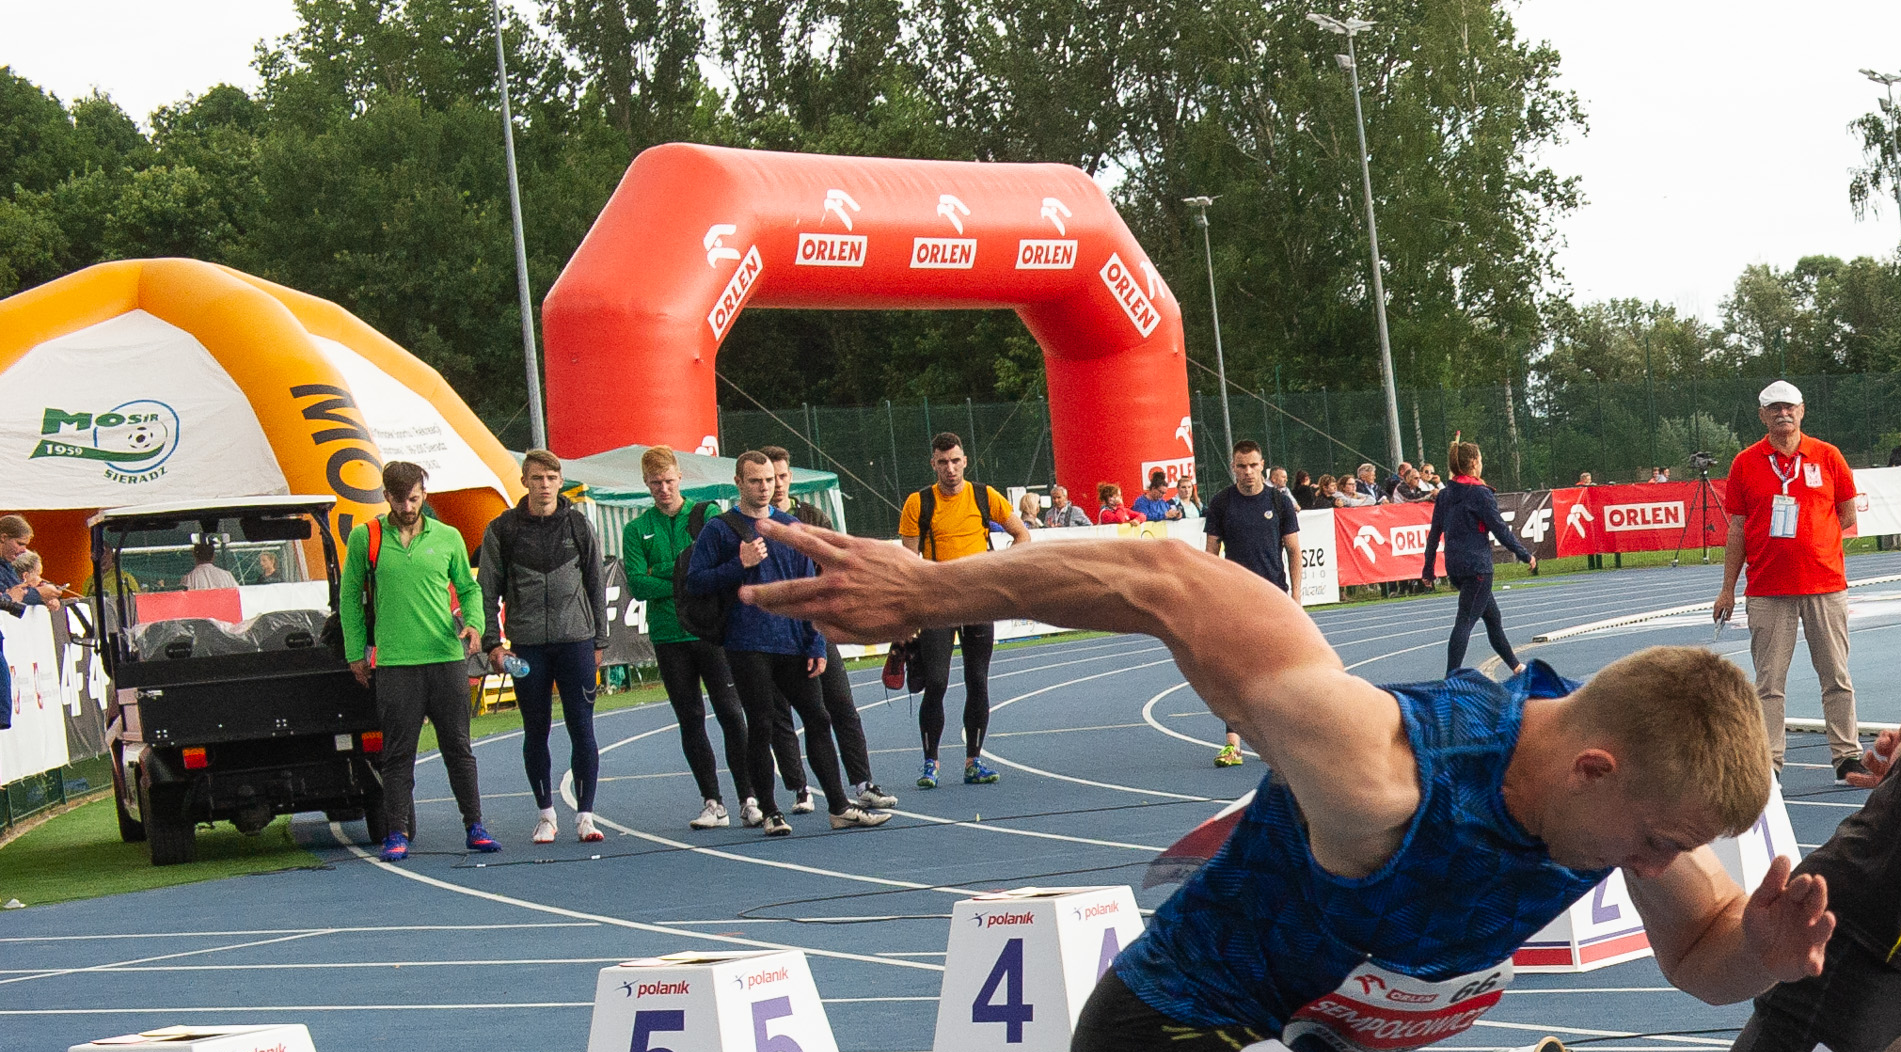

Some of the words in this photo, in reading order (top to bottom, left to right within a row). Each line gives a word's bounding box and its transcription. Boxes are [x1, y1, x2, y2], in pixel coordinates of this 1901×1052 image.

[802, 239, 863, 262] ORLEN
[916, 243, 972, 264] ORLEN
[1022, 245, 1074, 265] ORLEN
[715, 255, 759, 330] ORLEN
[1107, 263, 1154, 331] ORLEN
[45, 444, 83, 456] 1959
[1521, 508, 1552, 543] 4F
[1608, 506, 1679, 527] ORLEN
[987, 911, 1035, 928] polanik
[1084, 900, 1120, 920] polanik
[637, 979, 690, 998] polanik
[747, 966, 789, 989] polanik
[1450, 971, 1502, 1003] 66
[972, 938, 1034, 1044] 4
